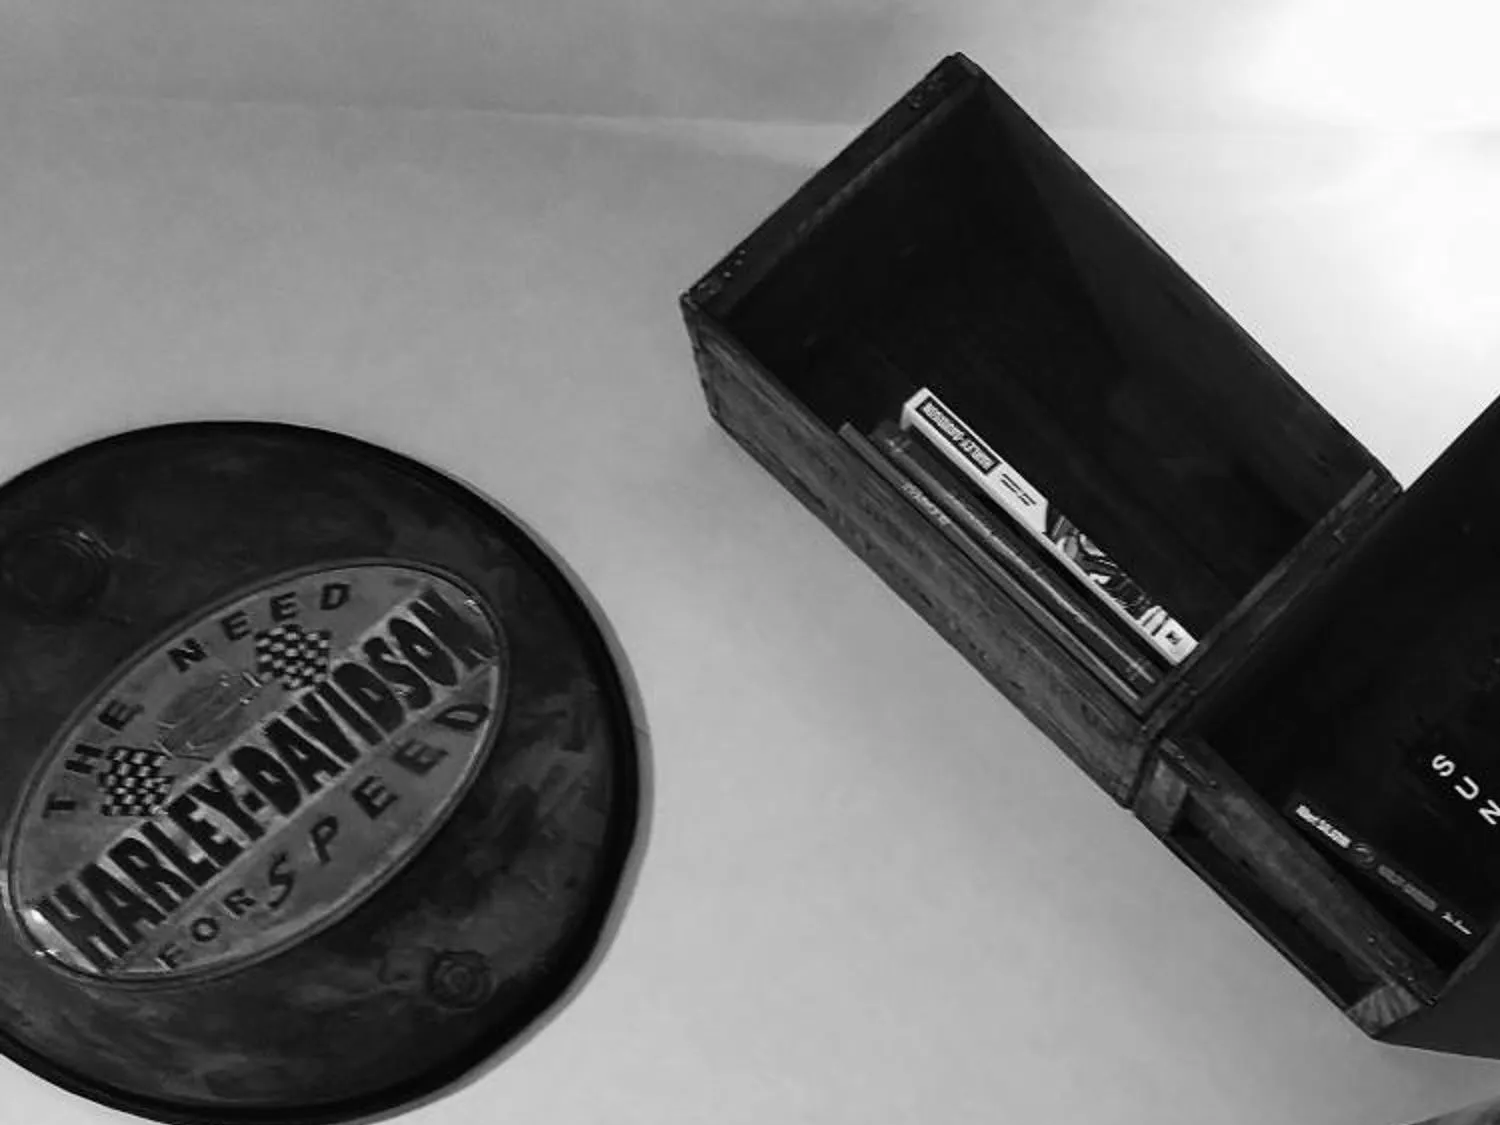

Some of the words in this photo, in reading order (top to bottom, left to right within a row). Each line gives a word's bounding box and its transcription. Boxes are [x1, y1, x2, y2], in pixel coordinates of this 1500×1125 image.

[37, 588, 498, 970] HARLEY-DAVIDSON
[44, 700, 141, 817] THE
[169, 584, 351, 673] NEED
[158, 888, 256, 970] FOR
[266, 703, 490, 911] SPEED
